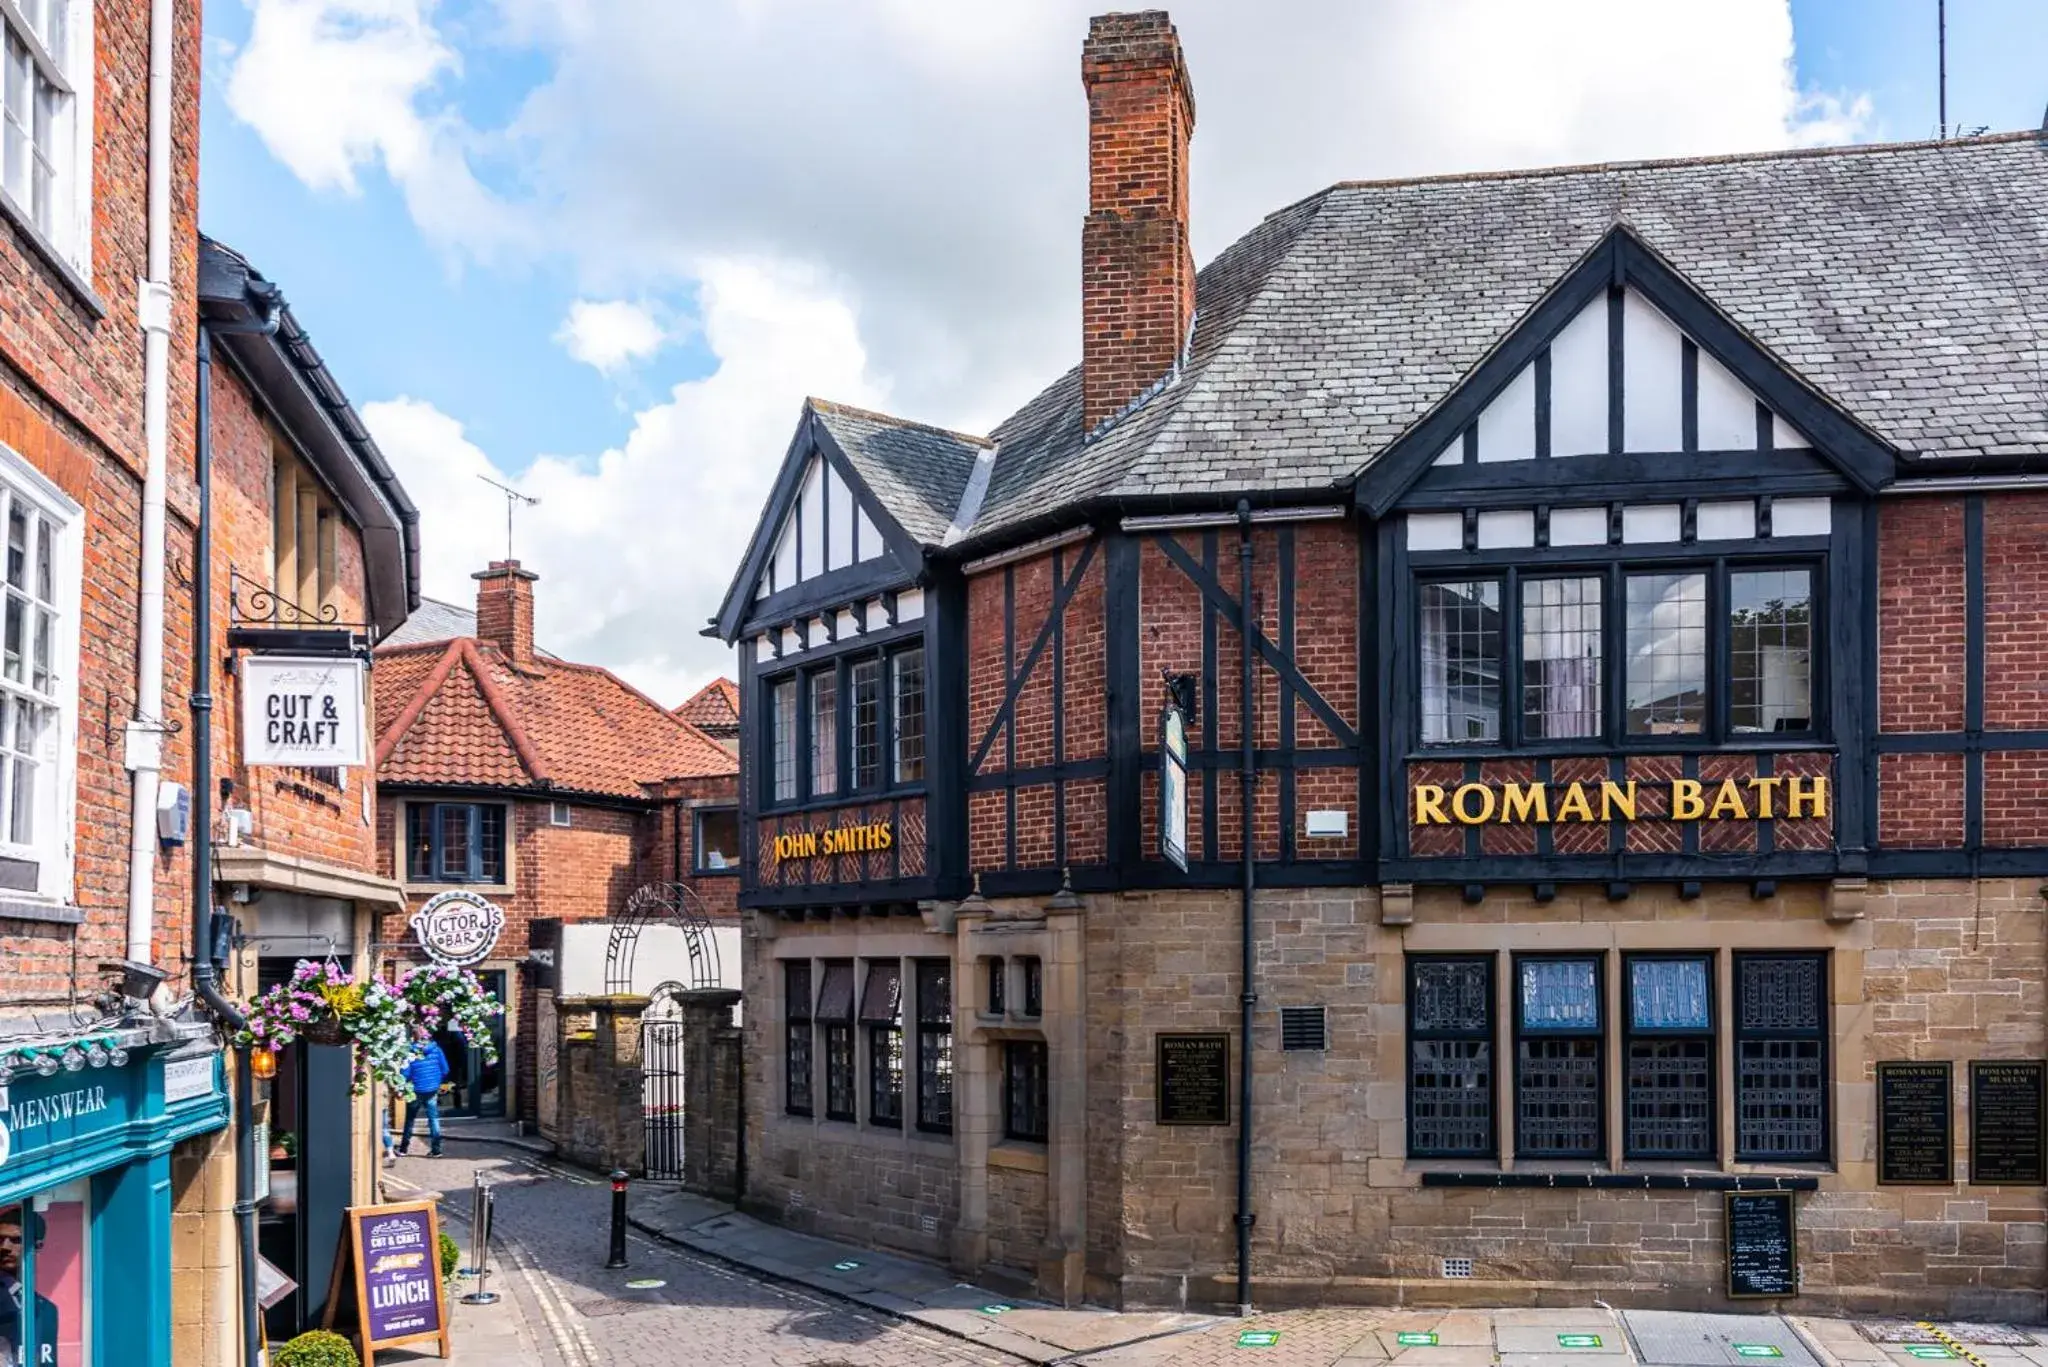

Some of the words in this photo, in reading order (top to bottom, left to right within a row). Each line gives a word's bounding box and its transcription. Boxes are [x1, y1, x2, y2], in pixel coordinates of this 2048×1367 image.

[267, 694, 312, 719] CUT
[323, 695, 338, 720] &
[268, 721, 339, 745] CRAFT
[1415, 781, 1637, 825] ROMAN
[1672, 776, 1827, 819] BATH
[773, 832, 817, 865] JOHN
[823, 822, 892, 855] SMITHS
[445, 932, 476, 947] BAR
[1886, 1068, 1918, 1076] ROMAN
[1979, 1067, 2012, 1076] ROMAN
[9, 1086, 107, 1132] MENSWEAR
[370, 1237, 387, 1249] CUT
[396, 1233, 421, 1245] CRAFT
[372, 1280, 430, 1309] LUNCH
